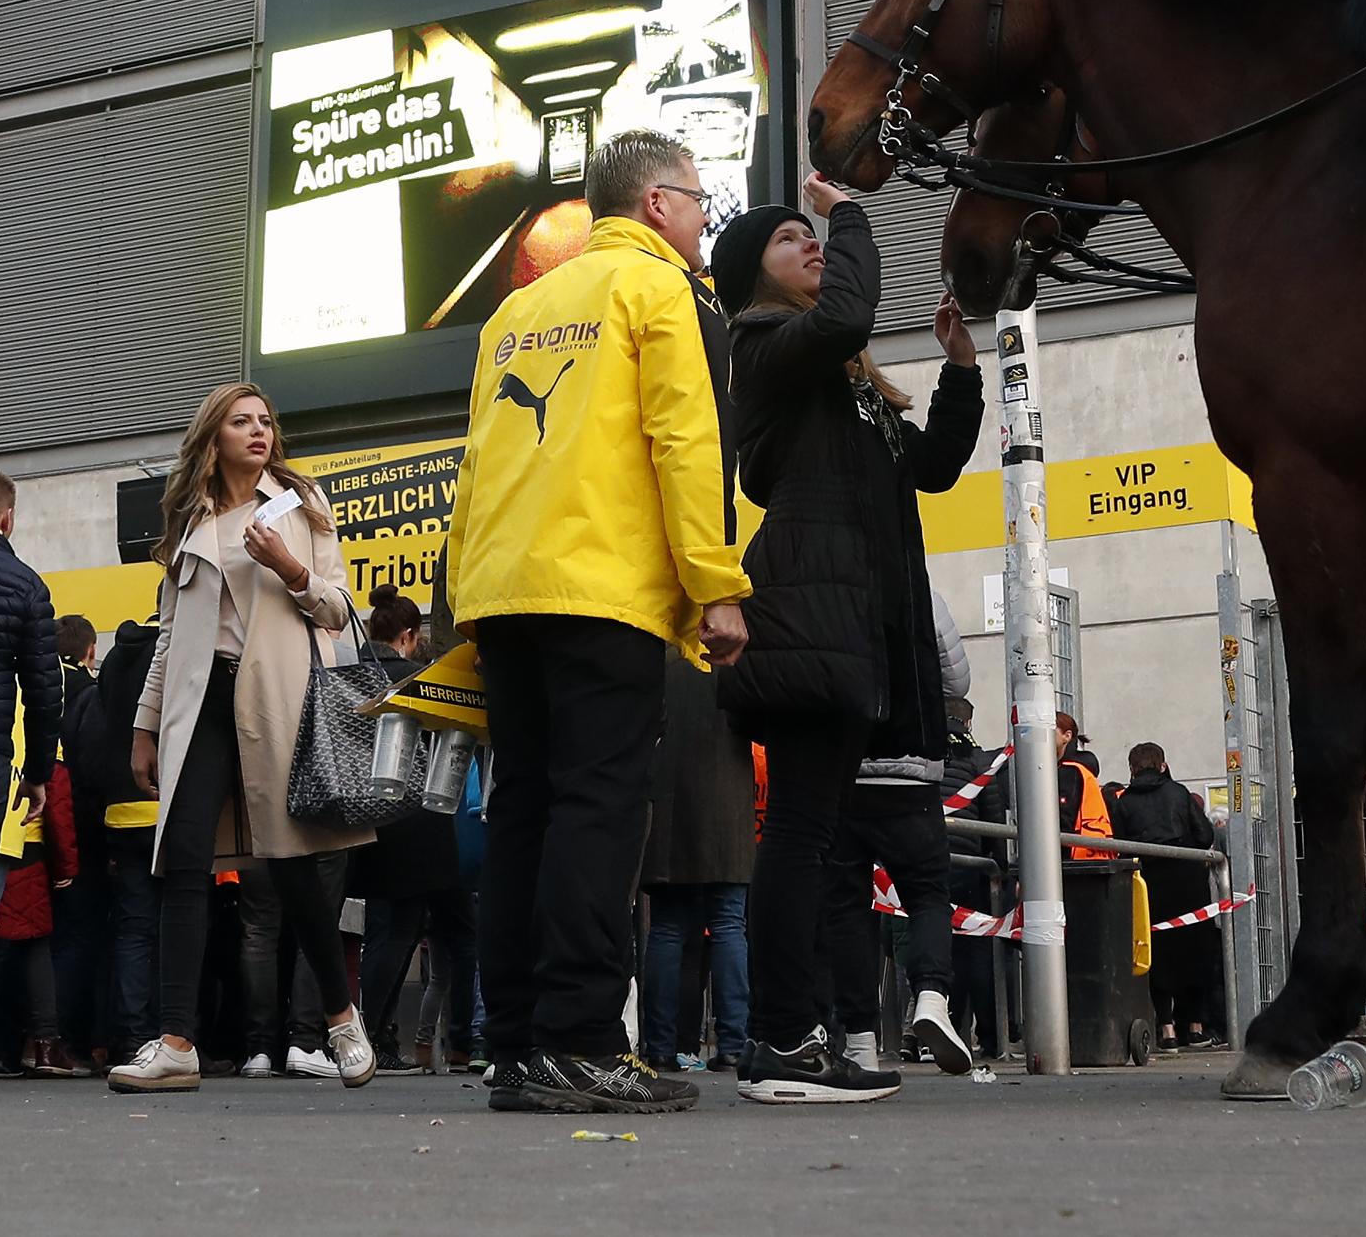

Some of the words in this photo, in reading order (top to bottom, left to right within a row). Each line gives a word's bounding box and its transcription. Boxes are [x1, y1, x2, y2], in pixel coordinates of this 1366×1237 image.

[292, 108, 382, 156] Spüre
[386, 91, 442, 128] das
[293, 121, 453, 195] Adrenalin!
[519, 321, 602, 351] EVONIK
[551, 342, 597, 354] INDUSTRIES
[312, 462, 328, 473] BVB
[329, 451, 382, 470] FanAbteilung
[331, 473, 369, 494] LIEBE
[371, 456, 459, 485] GÄSTE-FANS,
[1115, 462, 1157, 487] VIP
[333, 485, 435, 526] ERZLICH
[1089, 487, 1187, 515] Eingang
[350, 550, 438, 592] Tribü
